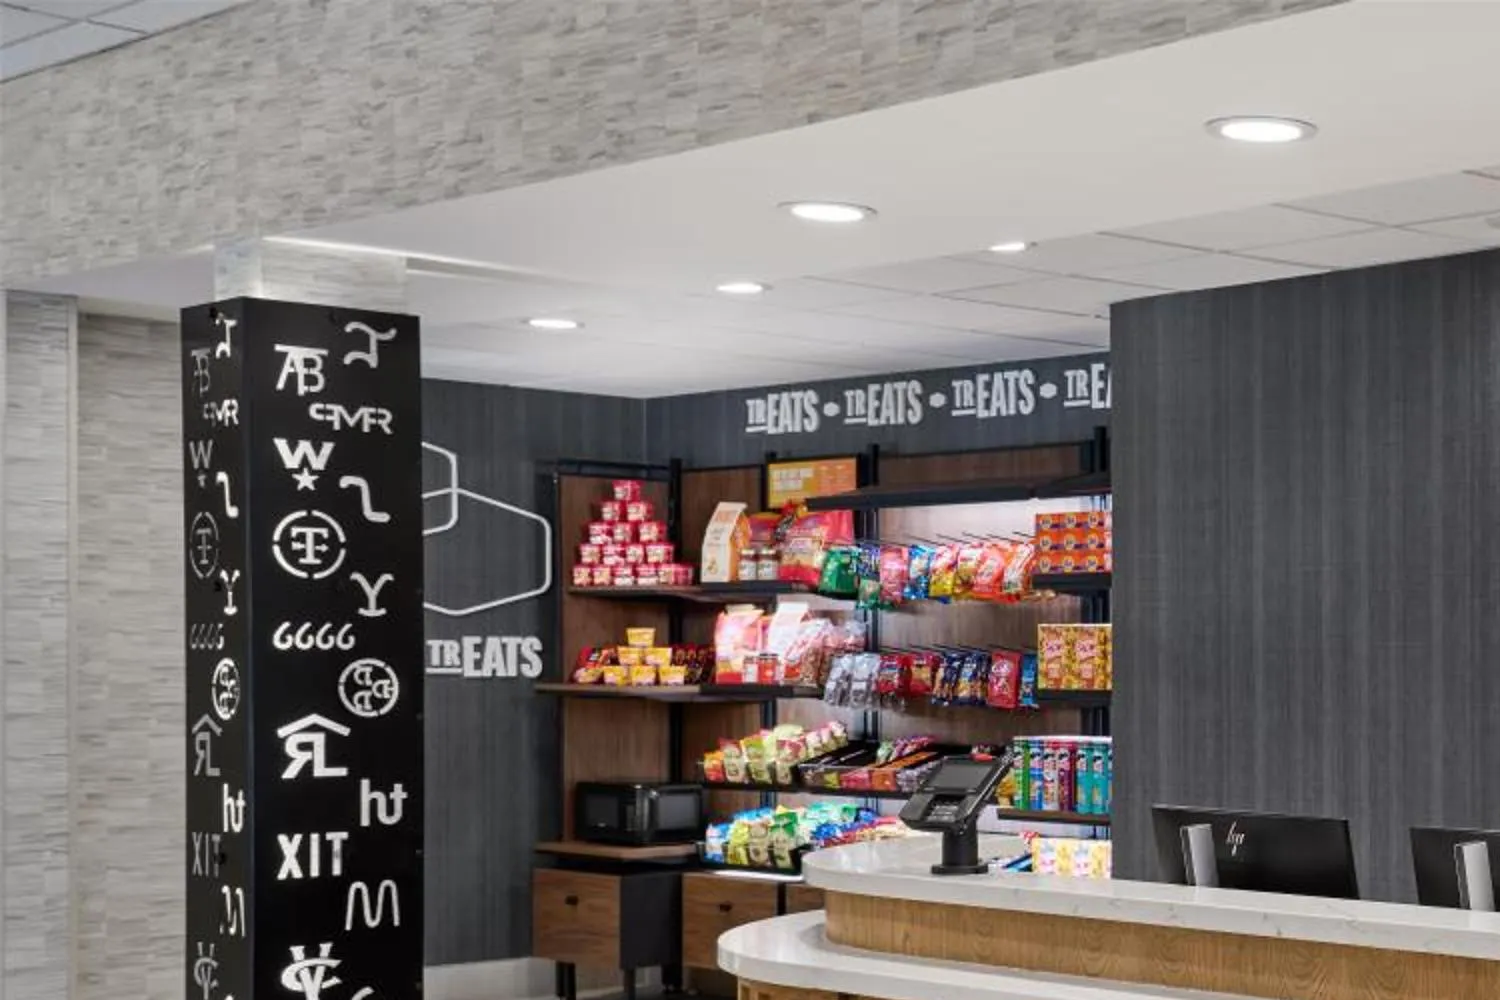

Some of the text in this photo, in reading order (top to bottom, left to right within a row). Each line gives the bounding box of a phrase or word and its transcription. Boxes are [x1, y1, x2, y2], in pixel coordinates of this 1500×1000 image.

[745, 390, 820, 435] TREATS
[844, 380, 923, 427] TREATS
[951, 368, 1036, 419] TREATS
[425, 635, 543, 678] TREATS
[276, 831, 349, 881] XIT
